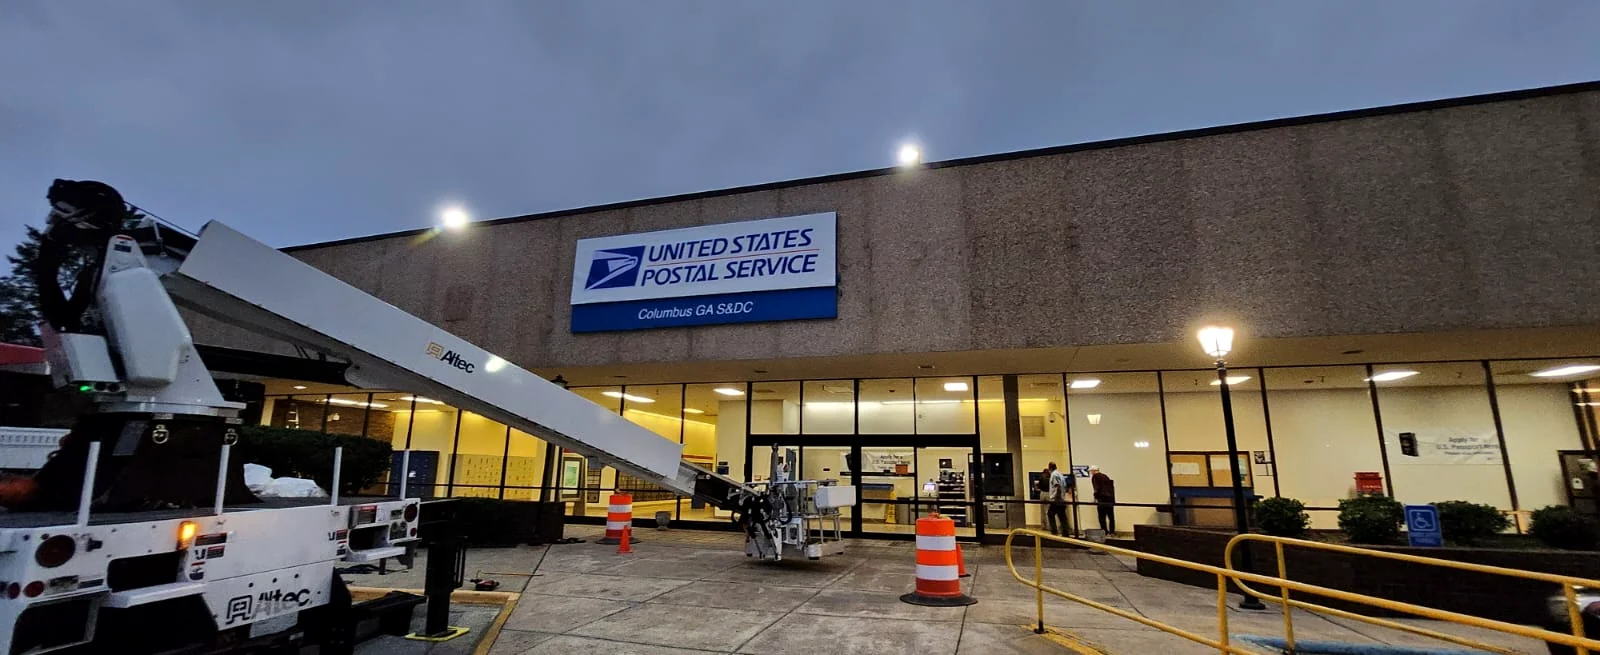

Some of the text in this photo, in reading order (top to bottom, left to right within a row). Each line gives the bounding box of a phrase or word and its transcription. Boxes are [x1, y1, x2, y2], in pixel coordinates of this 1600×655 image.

[649, 228, 813, 262] UNITED STATES
[641, 254, 819, 287] POSTAL SERVICE
[638, 301, 754, 320] Columbus GA S&DC
[440, 350, 475, 374] Altec
